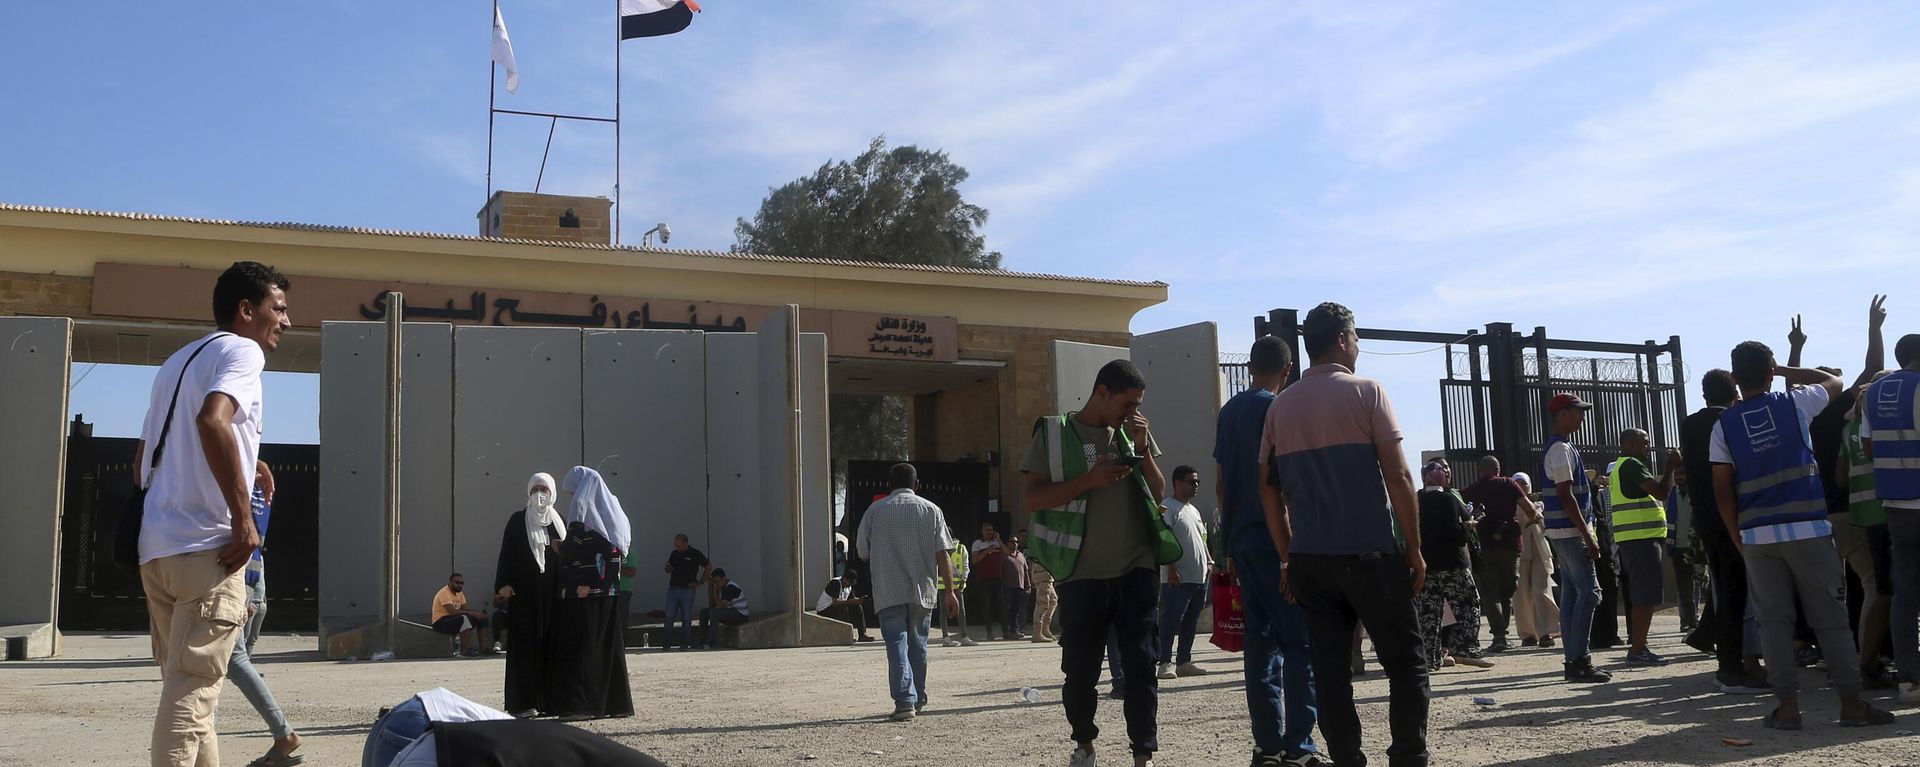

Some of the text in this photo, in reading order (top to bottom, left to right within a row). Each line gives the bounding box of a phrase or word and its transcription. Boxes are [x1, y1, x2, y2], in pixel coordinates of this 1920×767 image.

[492, 295, 621, 328] رفح
[876, 317, 926, 333] وزارة النقل
